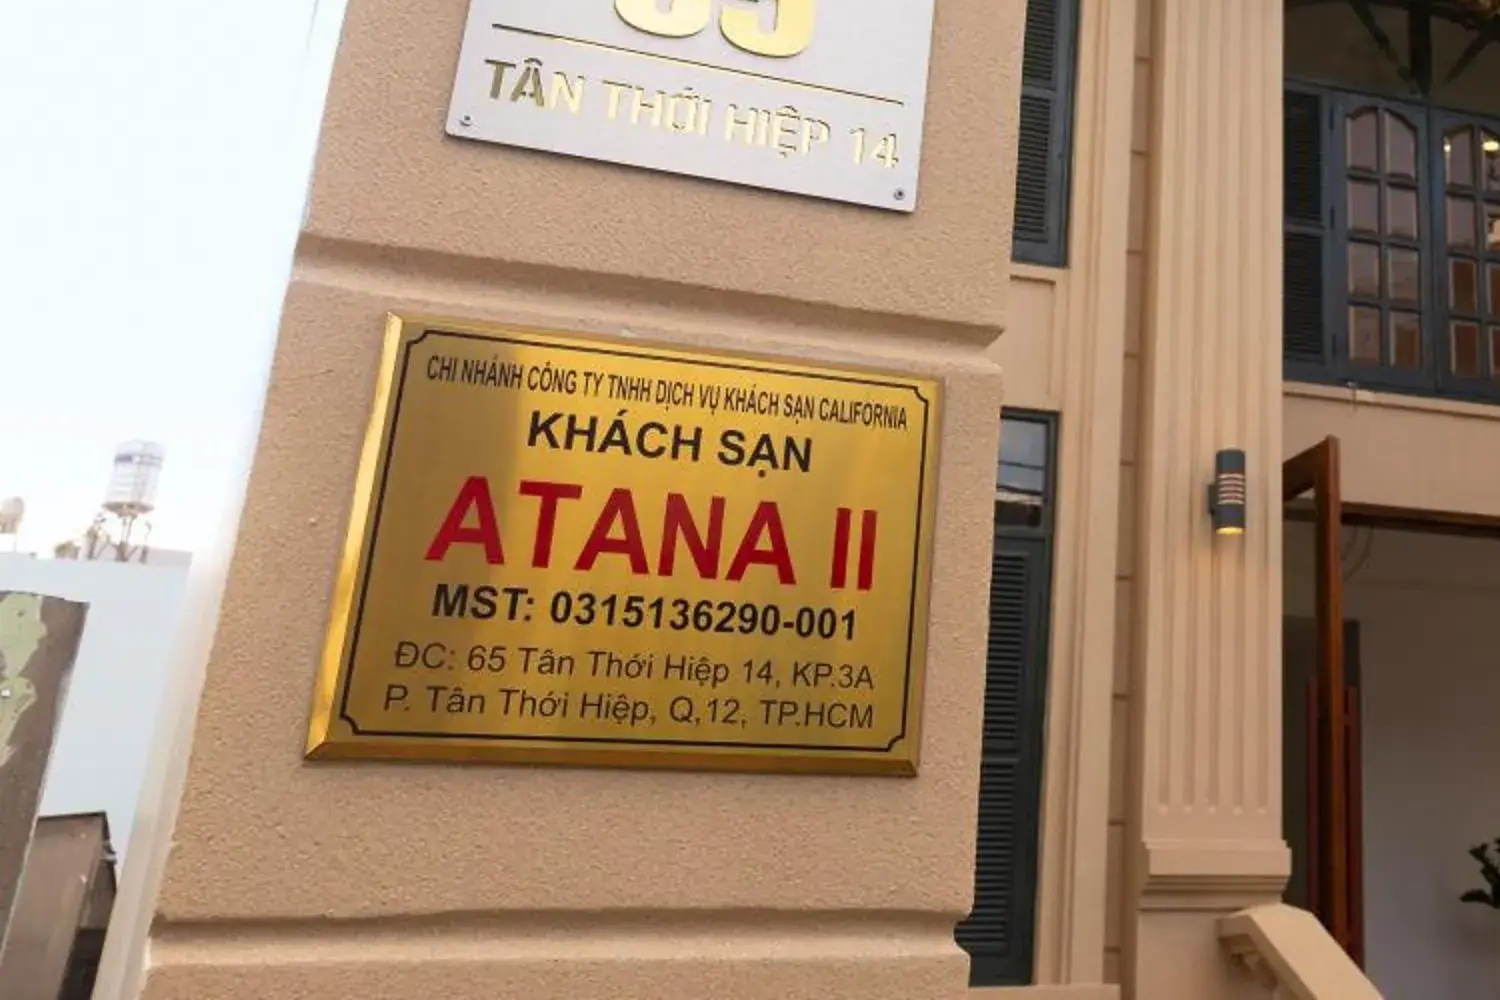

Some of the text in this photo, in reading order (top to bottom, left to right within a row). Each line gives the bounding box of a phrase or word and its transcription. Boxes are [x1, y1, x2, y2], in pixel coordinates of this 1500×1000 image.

[484, 57, 899, 169] TÂN THỚI HIỆP 14
[427, 354, 908, 431] CHI NHÁNH CÔNG TY TNHH DỊCH VỤ KHÁCH SẠN CALIFORNIA
[527, 408, 813, 478] KHÁCH SẠN
[424, 474, 877, 592] ATANA II
[432, 583, 856, 641] MST: 0315136290-001
[393, 640, 875, 690] ĐC: 65 Tân Thới Hiệp 14, KP.3A
[383, 684, 411, 711] P.
[427, 685, 486, 715] Tân
[498, 688, 569, 718] Thới
[579, 692, 656, 727] Hiệp,
[759, 699, 875, 730] TP.HCM
